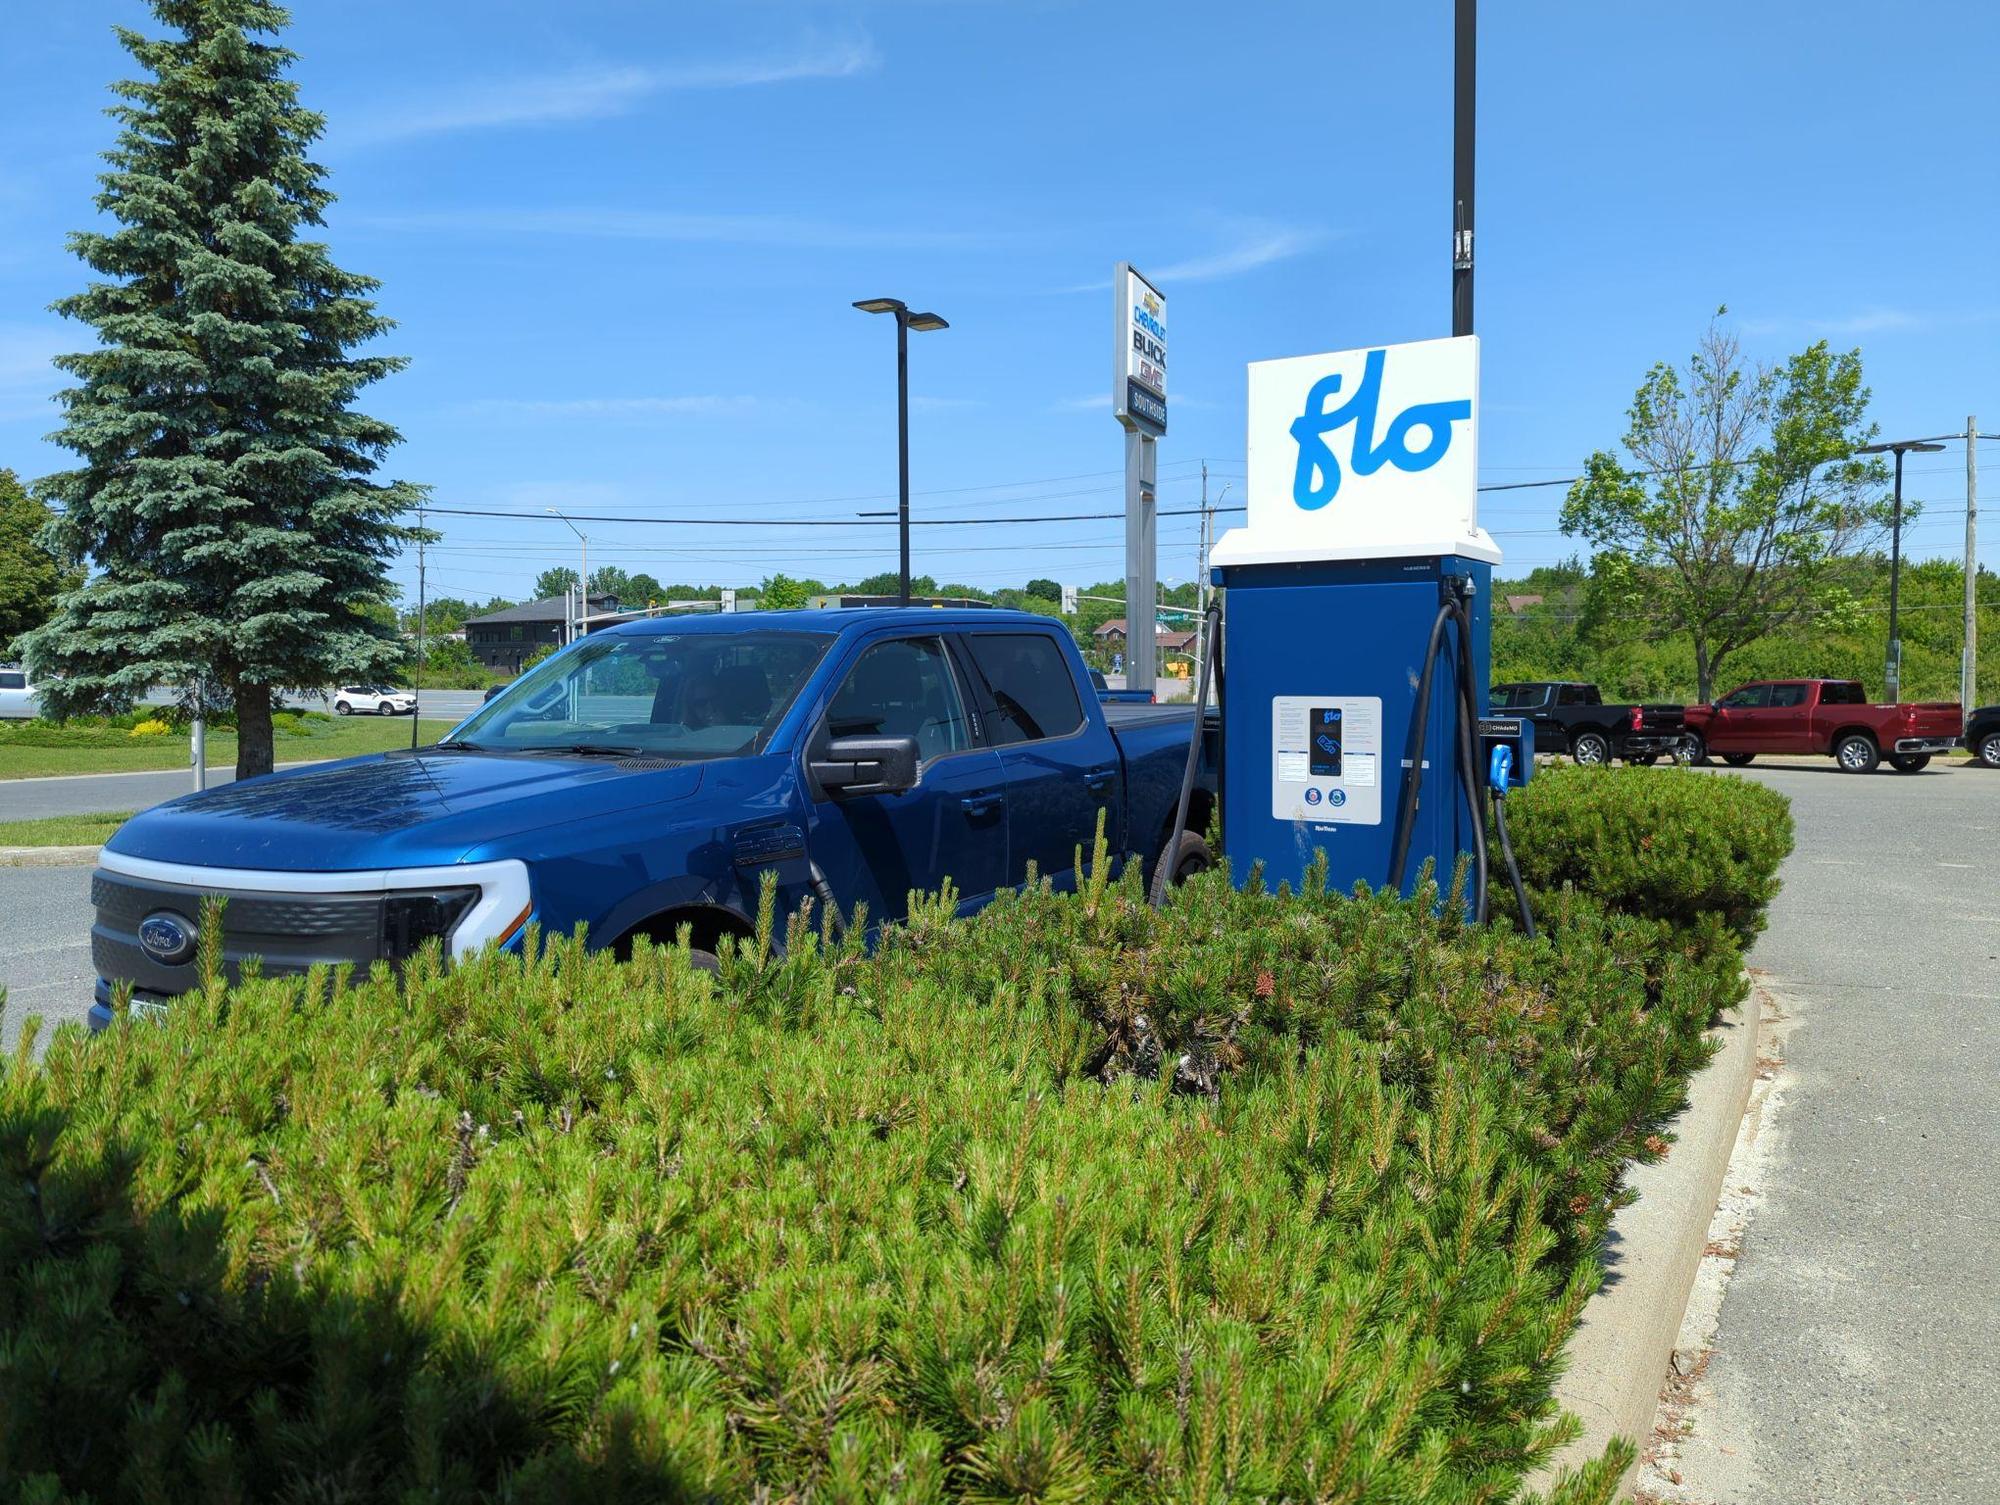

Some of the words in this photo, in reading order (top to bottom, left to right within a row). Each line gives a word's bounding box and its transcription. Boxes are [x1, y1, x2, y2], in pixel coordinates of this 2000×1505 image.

[1134, 305, 1166, 343] CHEVROLET
[1133, 329, 1167, 369] BUICK
[1140, 360, 1163, 391] GMC
[1134, 392, 1166, 423] SOUTHSIDE
[1289, 349, 1471, 511] flo
[146, 928, 172, 947] Ford
